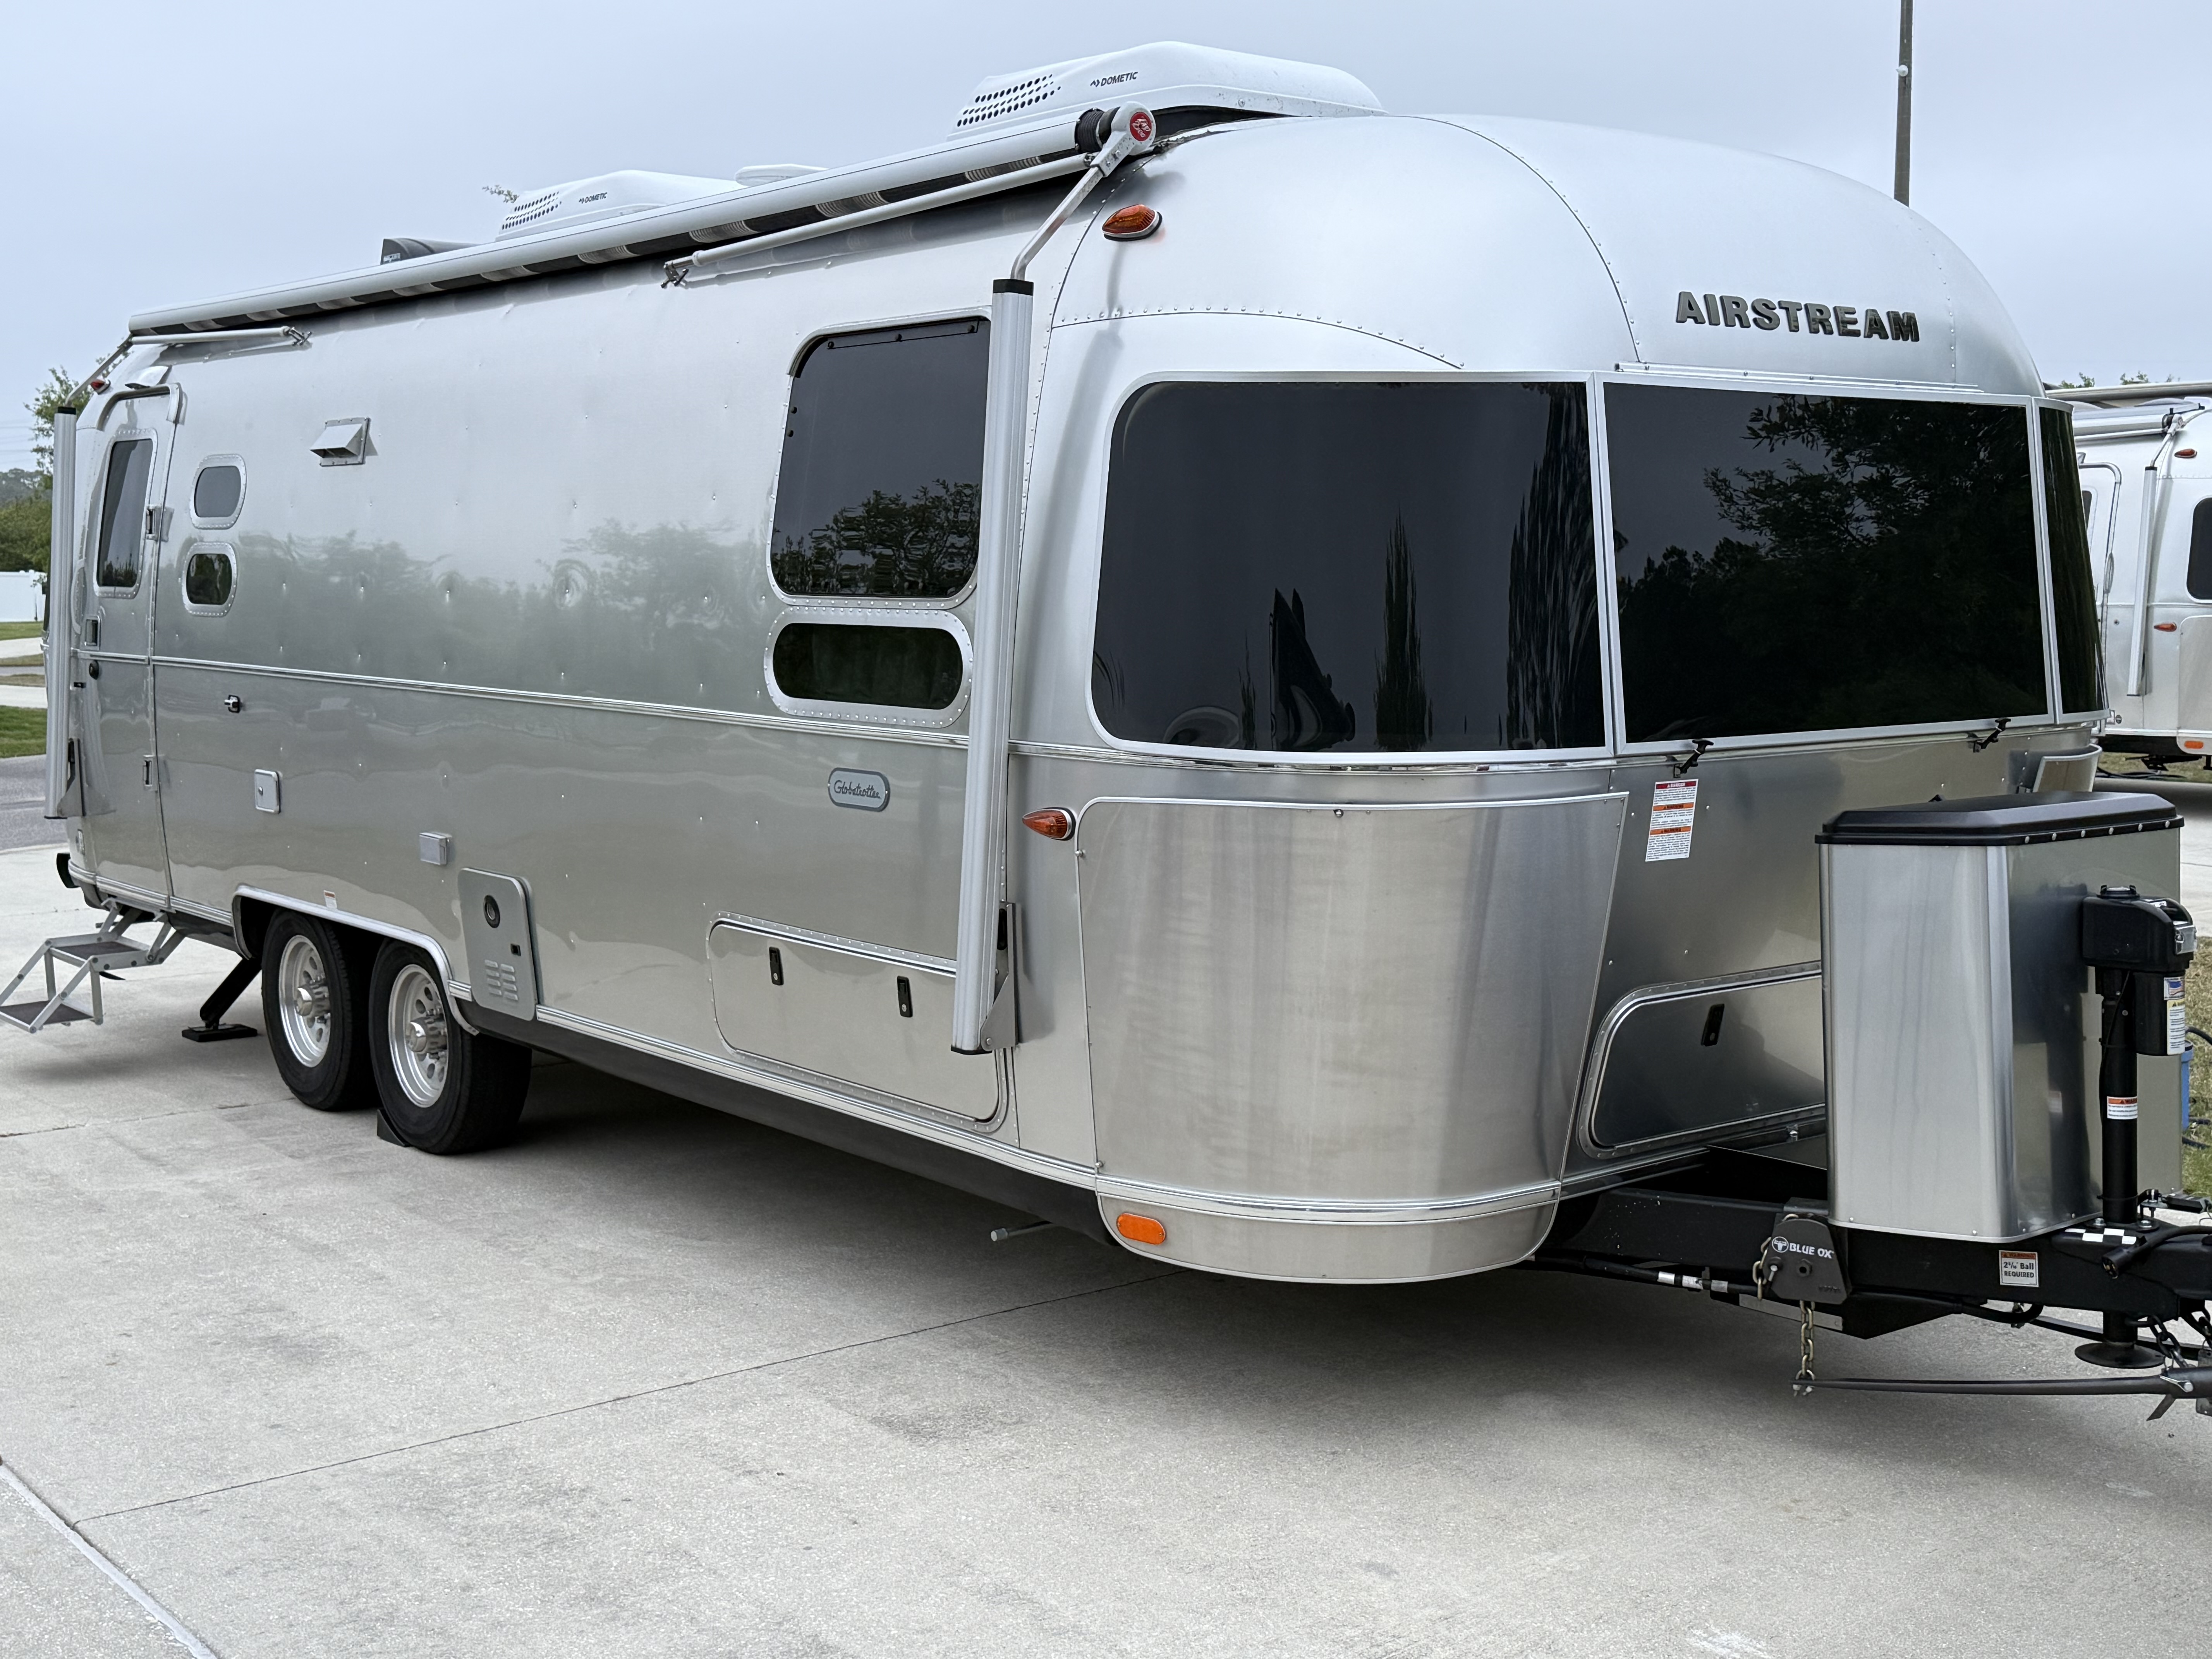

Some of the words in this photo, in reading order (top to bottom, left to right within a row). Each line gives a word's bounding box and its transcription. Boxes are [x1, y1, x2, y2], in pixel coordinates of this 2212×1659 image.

[1101, 72, 1139, 86] DOMETIC
[1675, 291, 1920, 342] AIRSTREAM
[1789, 1243, 1815, 1255] BLUE
[1817, 1248, 1832, 1259] OX
